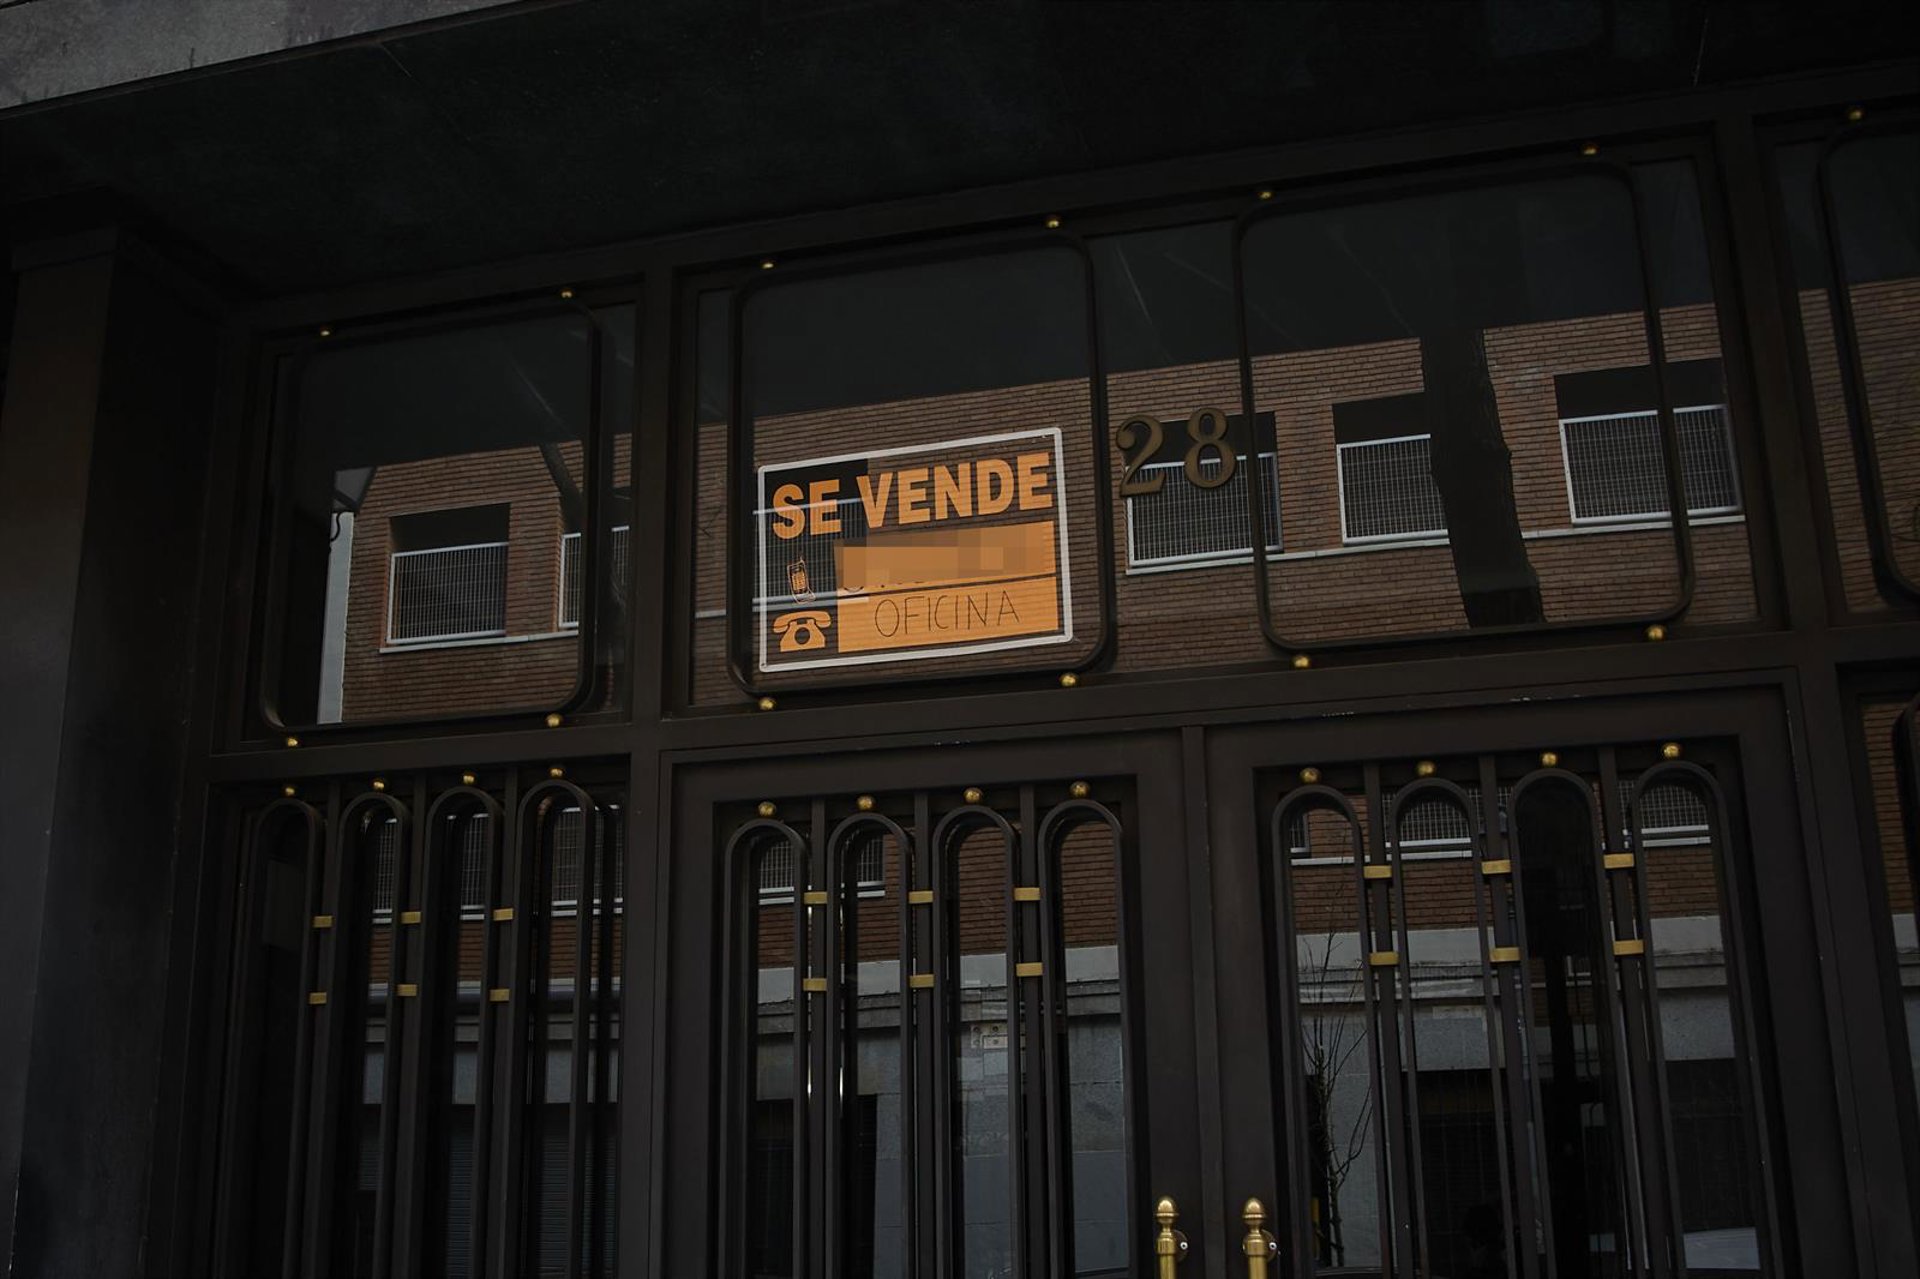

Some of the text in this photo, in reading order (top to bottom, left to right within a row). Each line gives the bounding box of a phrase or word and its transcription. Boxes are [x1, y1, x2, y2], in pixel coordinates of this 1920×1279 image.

[771, 452, 1053, 540] SE VENDE
[1116, 408, 1236, 497] 28
[874, 590, 1020, 638] OFICINA
